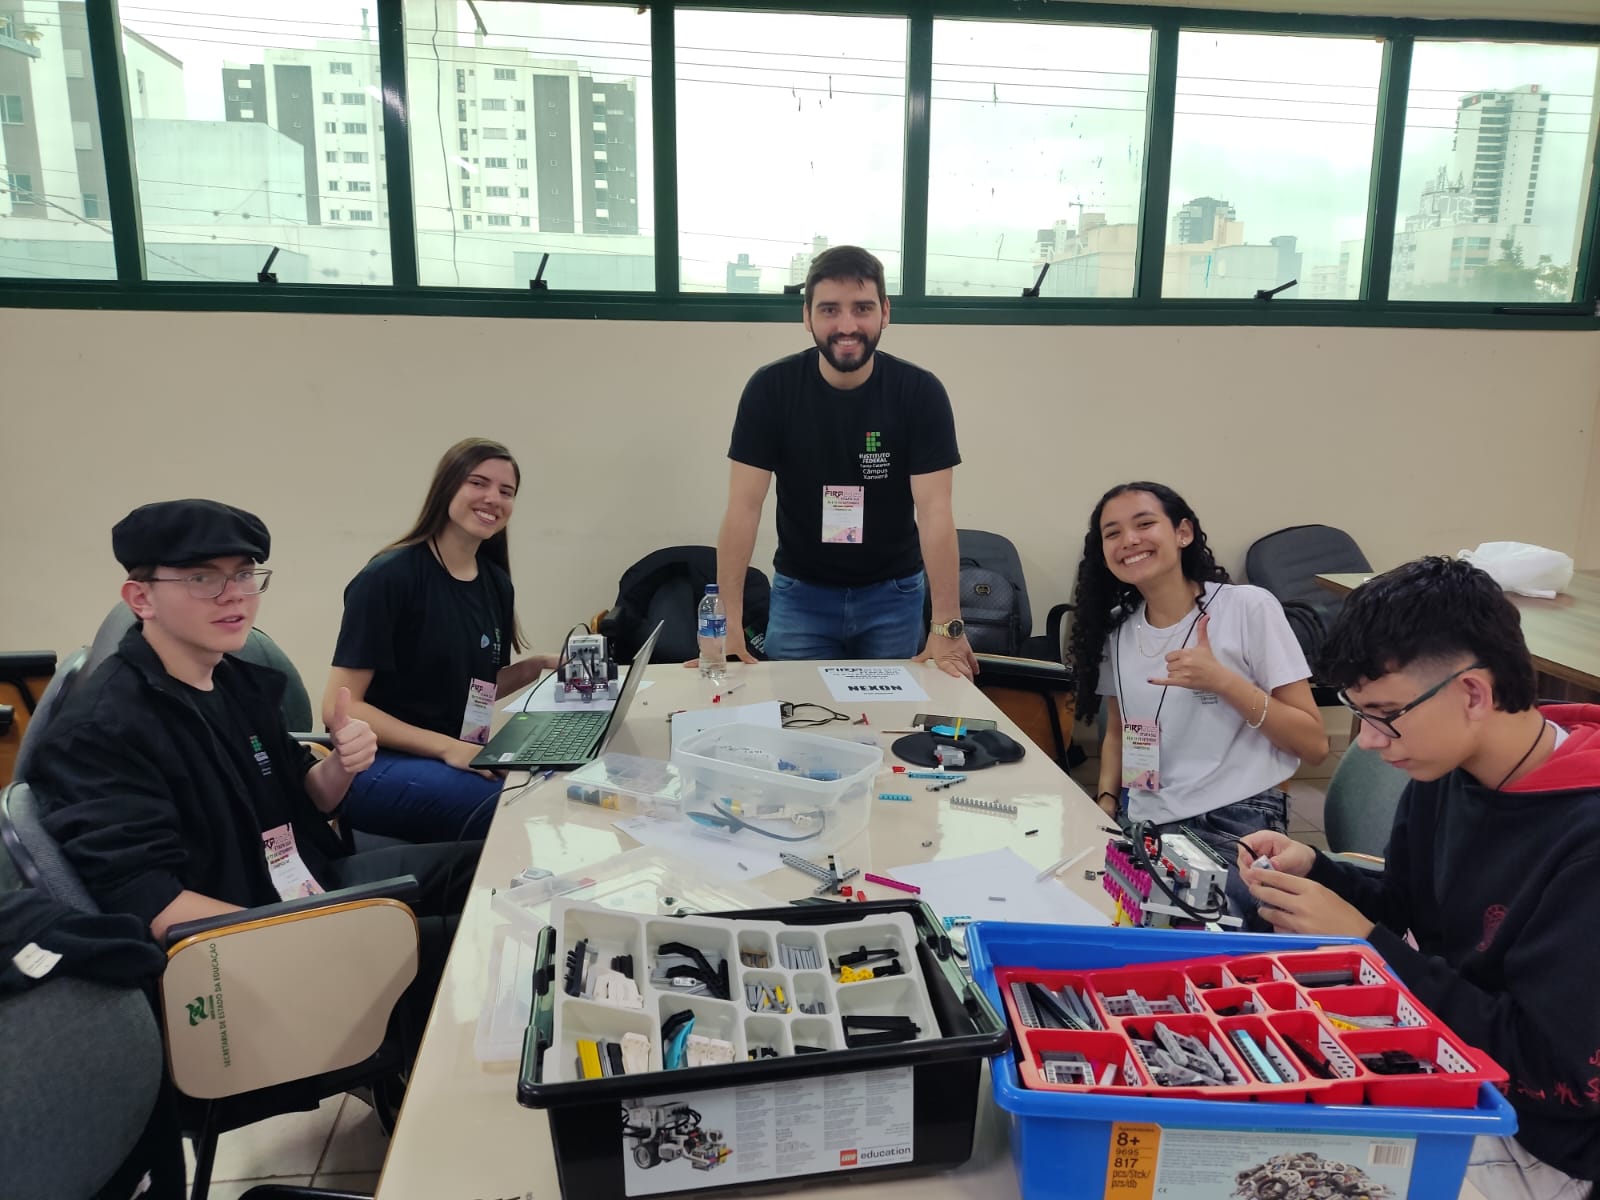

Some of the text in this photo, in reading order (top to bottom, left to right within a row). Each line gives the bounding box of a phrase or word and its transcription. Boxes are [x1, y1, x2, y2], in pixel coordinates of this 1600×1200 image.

[210, 943, 231, 1068] SECRETARIA DE ESTADO DA EDUCAÇÃO
[1117, 1132, 1140, 1146] 8+
[861, 1146, 911, 1159] education
[1115, 1148, 1139, 1156] 9695
[1114, 1157, 1139, 1169] 817
